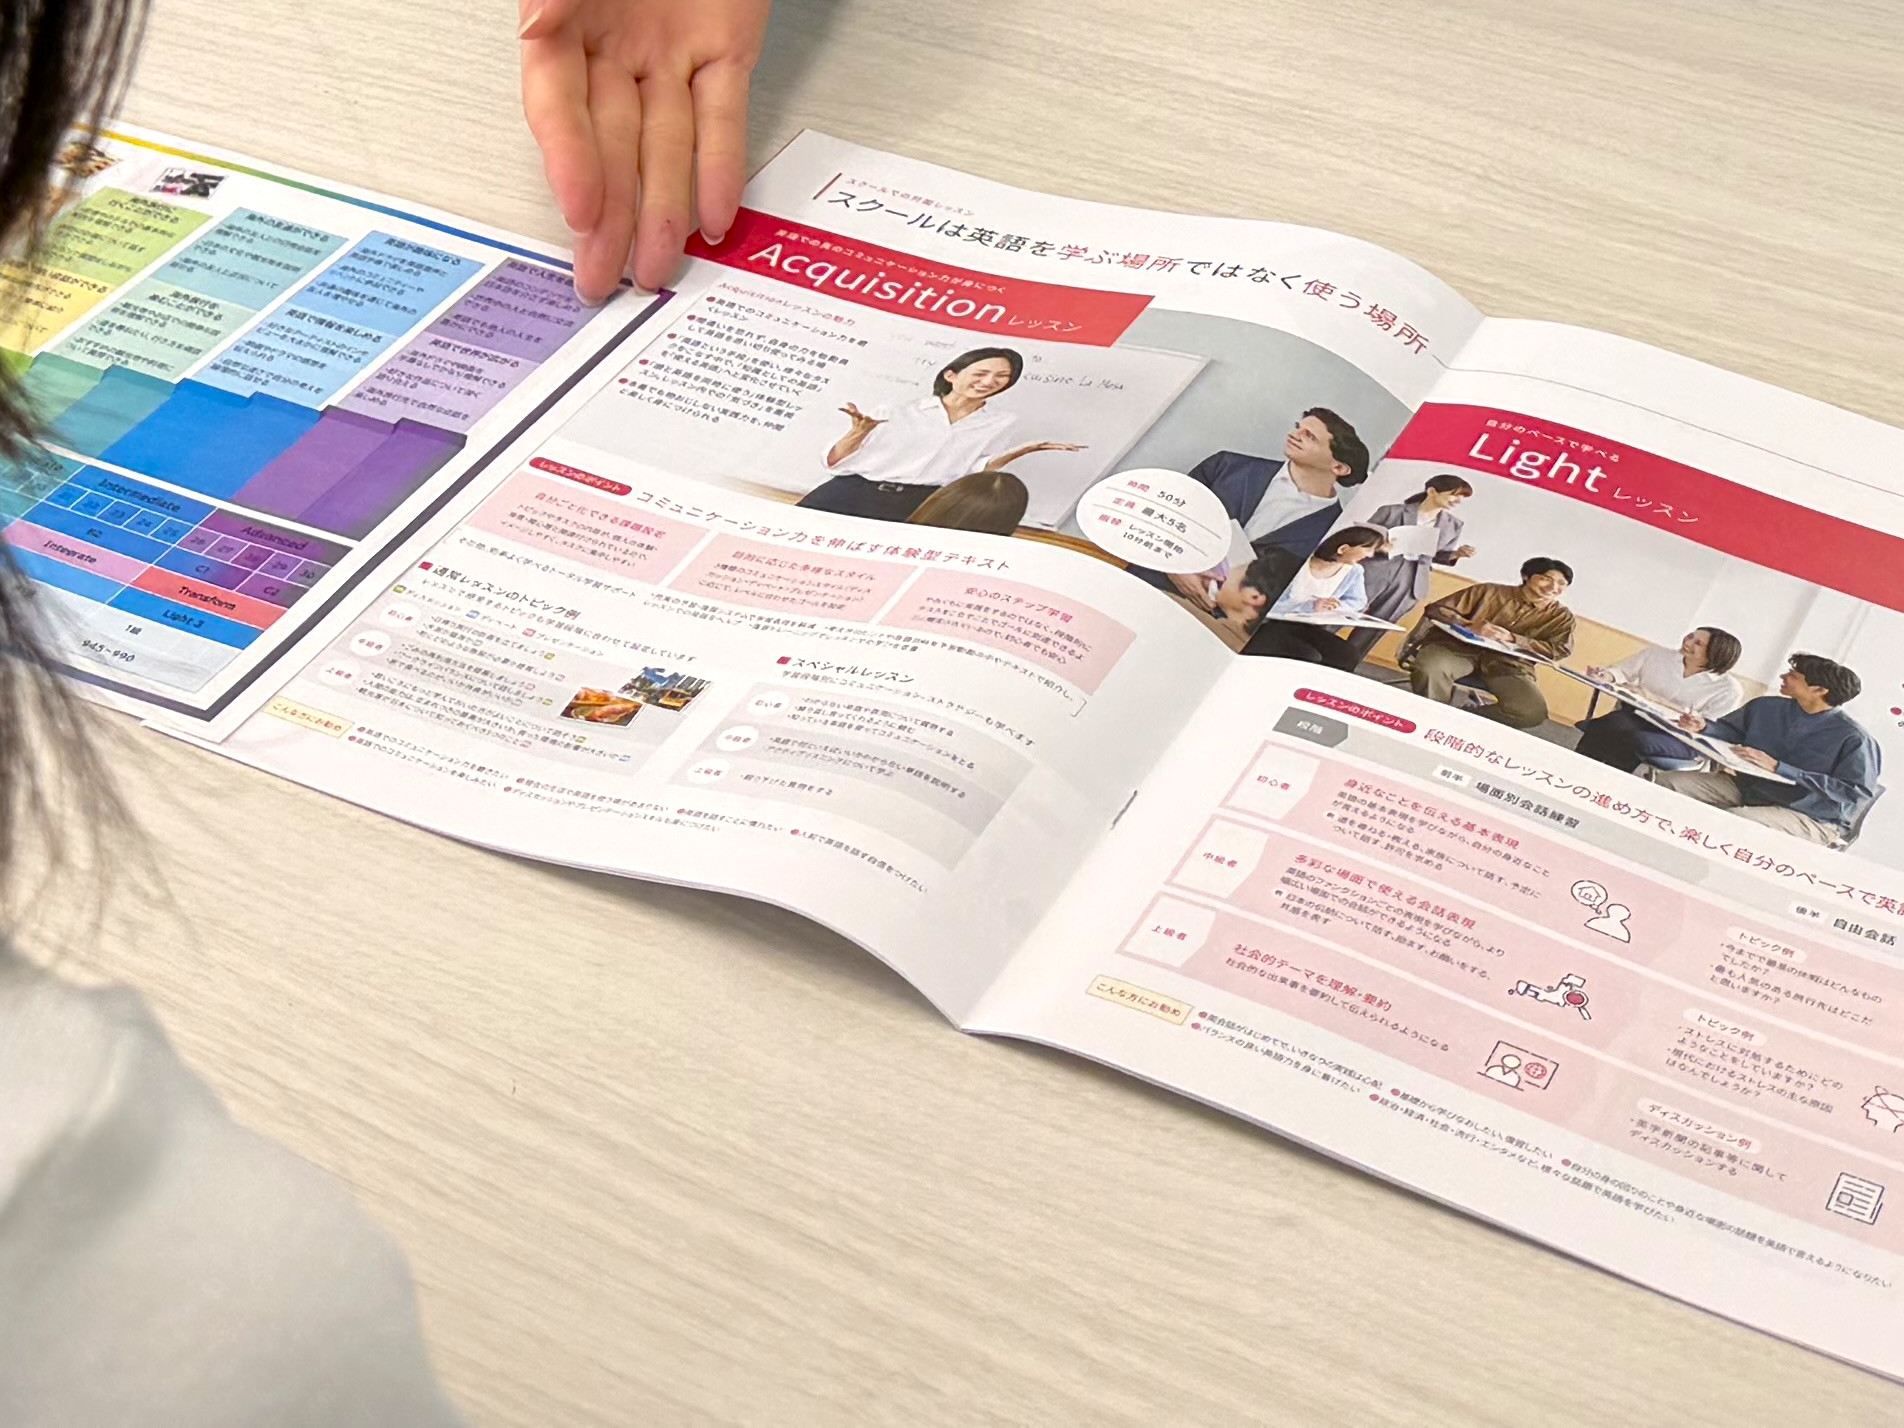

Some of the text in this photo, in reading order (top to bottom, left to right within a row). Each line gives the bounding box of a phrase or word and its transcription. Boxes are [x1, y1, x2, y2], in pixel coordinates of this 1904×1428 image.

[748, 243, 1083, 334] Acquisition レッスン
[828, 190, 1429, 355] スクールは英語を学ぶ場所ではなく使う場所
[1485, 419, 1620, 463] 自分のペースで学べる
[99, 478, 181, 513] Intermediate
[1469, 433, 1699, 523] Light レッスン
[242, 525, 308, 550] Advanced
[179, 586, 237, 611] Transform
[1343, 778, 1521, 850] 身近なことを伝える基本表現
[1475, 780, 1581, 830] 場面別会話練習
[1294, 853, 1476, 930] 多彩な場面で使える会話表現
[1738, 932, 1795, 958] トピック例
[1833, 918, 1898, 947] 自由会話
[1234, 943, 1392, 1012] 社会的テーマを理解・要約
[1696, 1014, 1754, 1042] トピック例
